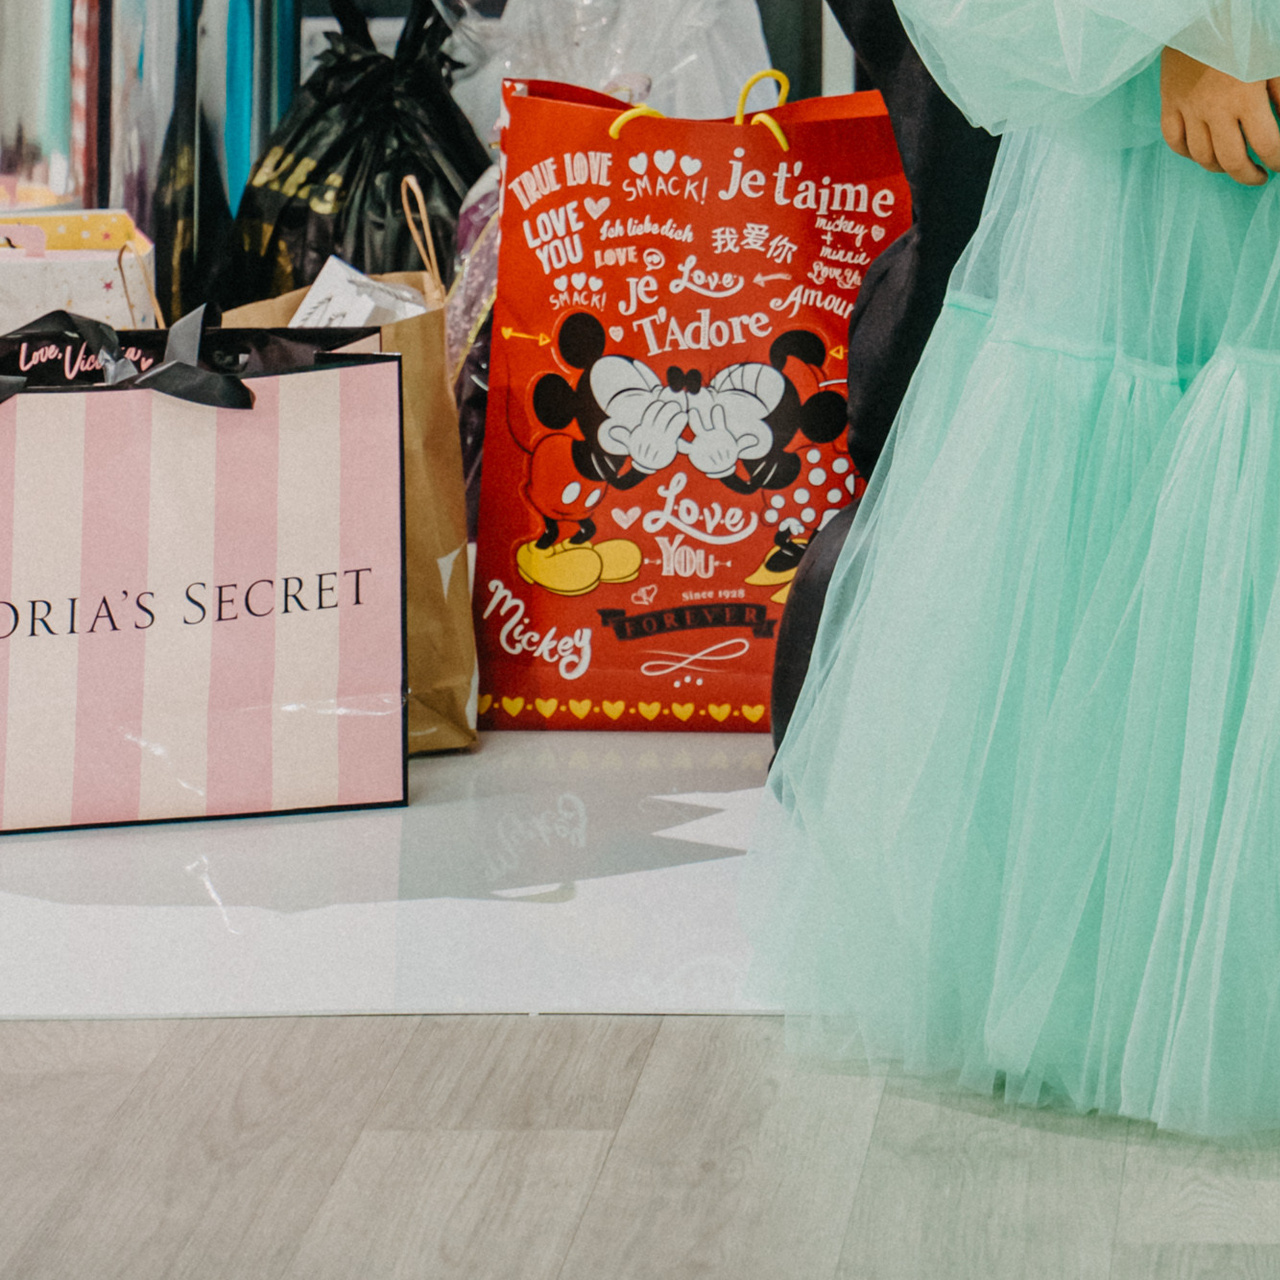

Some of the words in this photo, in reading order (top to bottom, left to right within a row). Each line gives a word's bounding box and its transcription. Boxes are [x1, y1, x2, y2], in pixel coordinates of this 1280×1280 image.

[507, 157, 562, 211] TRUE
[563, 151, 613, 187] LOVE
[622, 175, 709, 206] SMACK!
[718, 147, 766, 201] je
[772, 160, 895, 218] t'aime
[523, 200, 585, 249] LOVE
[599, 219, 624, 241] Ich
[627, 214, 660, 237] liebe
[660, 218, 695, 243] dich
[712, 222, 798, 264] 我爱你
[535, 233, 584, 275] YOU
[593, 245, 638, 269] LOVE
[669, 254, 745, 299] Love
[549, 290, 607, 312] SMACK!
[642, 472, 758, 545] Love
[183, 568, 372, 626] SECRET
[681, 589, 715, 602] Since
[718, 588, 746, 599] 1928
[483, 579, 592, 680] Mickey
[624, 607, 757, 637] FOREVER
